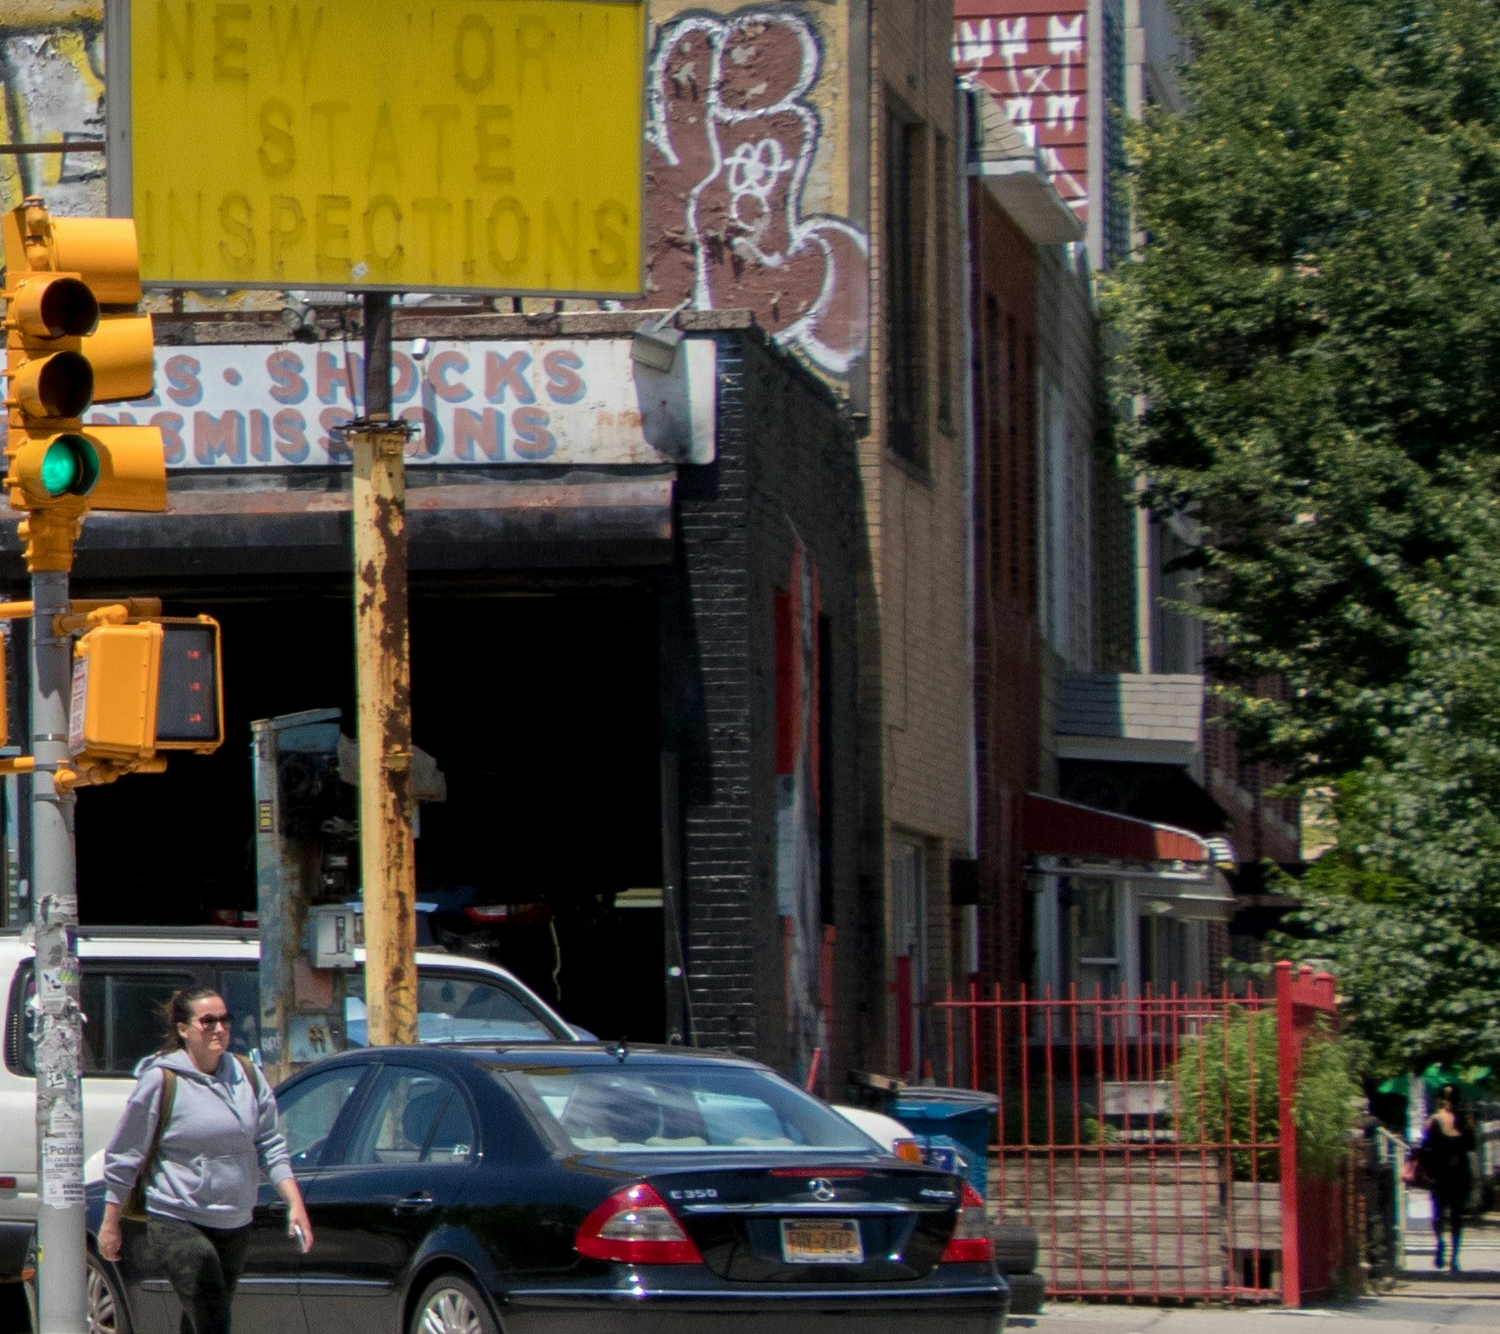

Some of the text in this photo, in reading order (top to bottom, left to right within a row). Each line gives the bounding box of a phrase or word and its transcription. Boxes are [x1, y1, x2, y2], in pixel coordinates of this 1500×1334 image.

[156, 0, 325, 85] NEW
[257, 99, 515, 183] STATE
[142, 188, 630, 279] INSPECTIONS
[266, 349, 587, 406] SHOCKS
